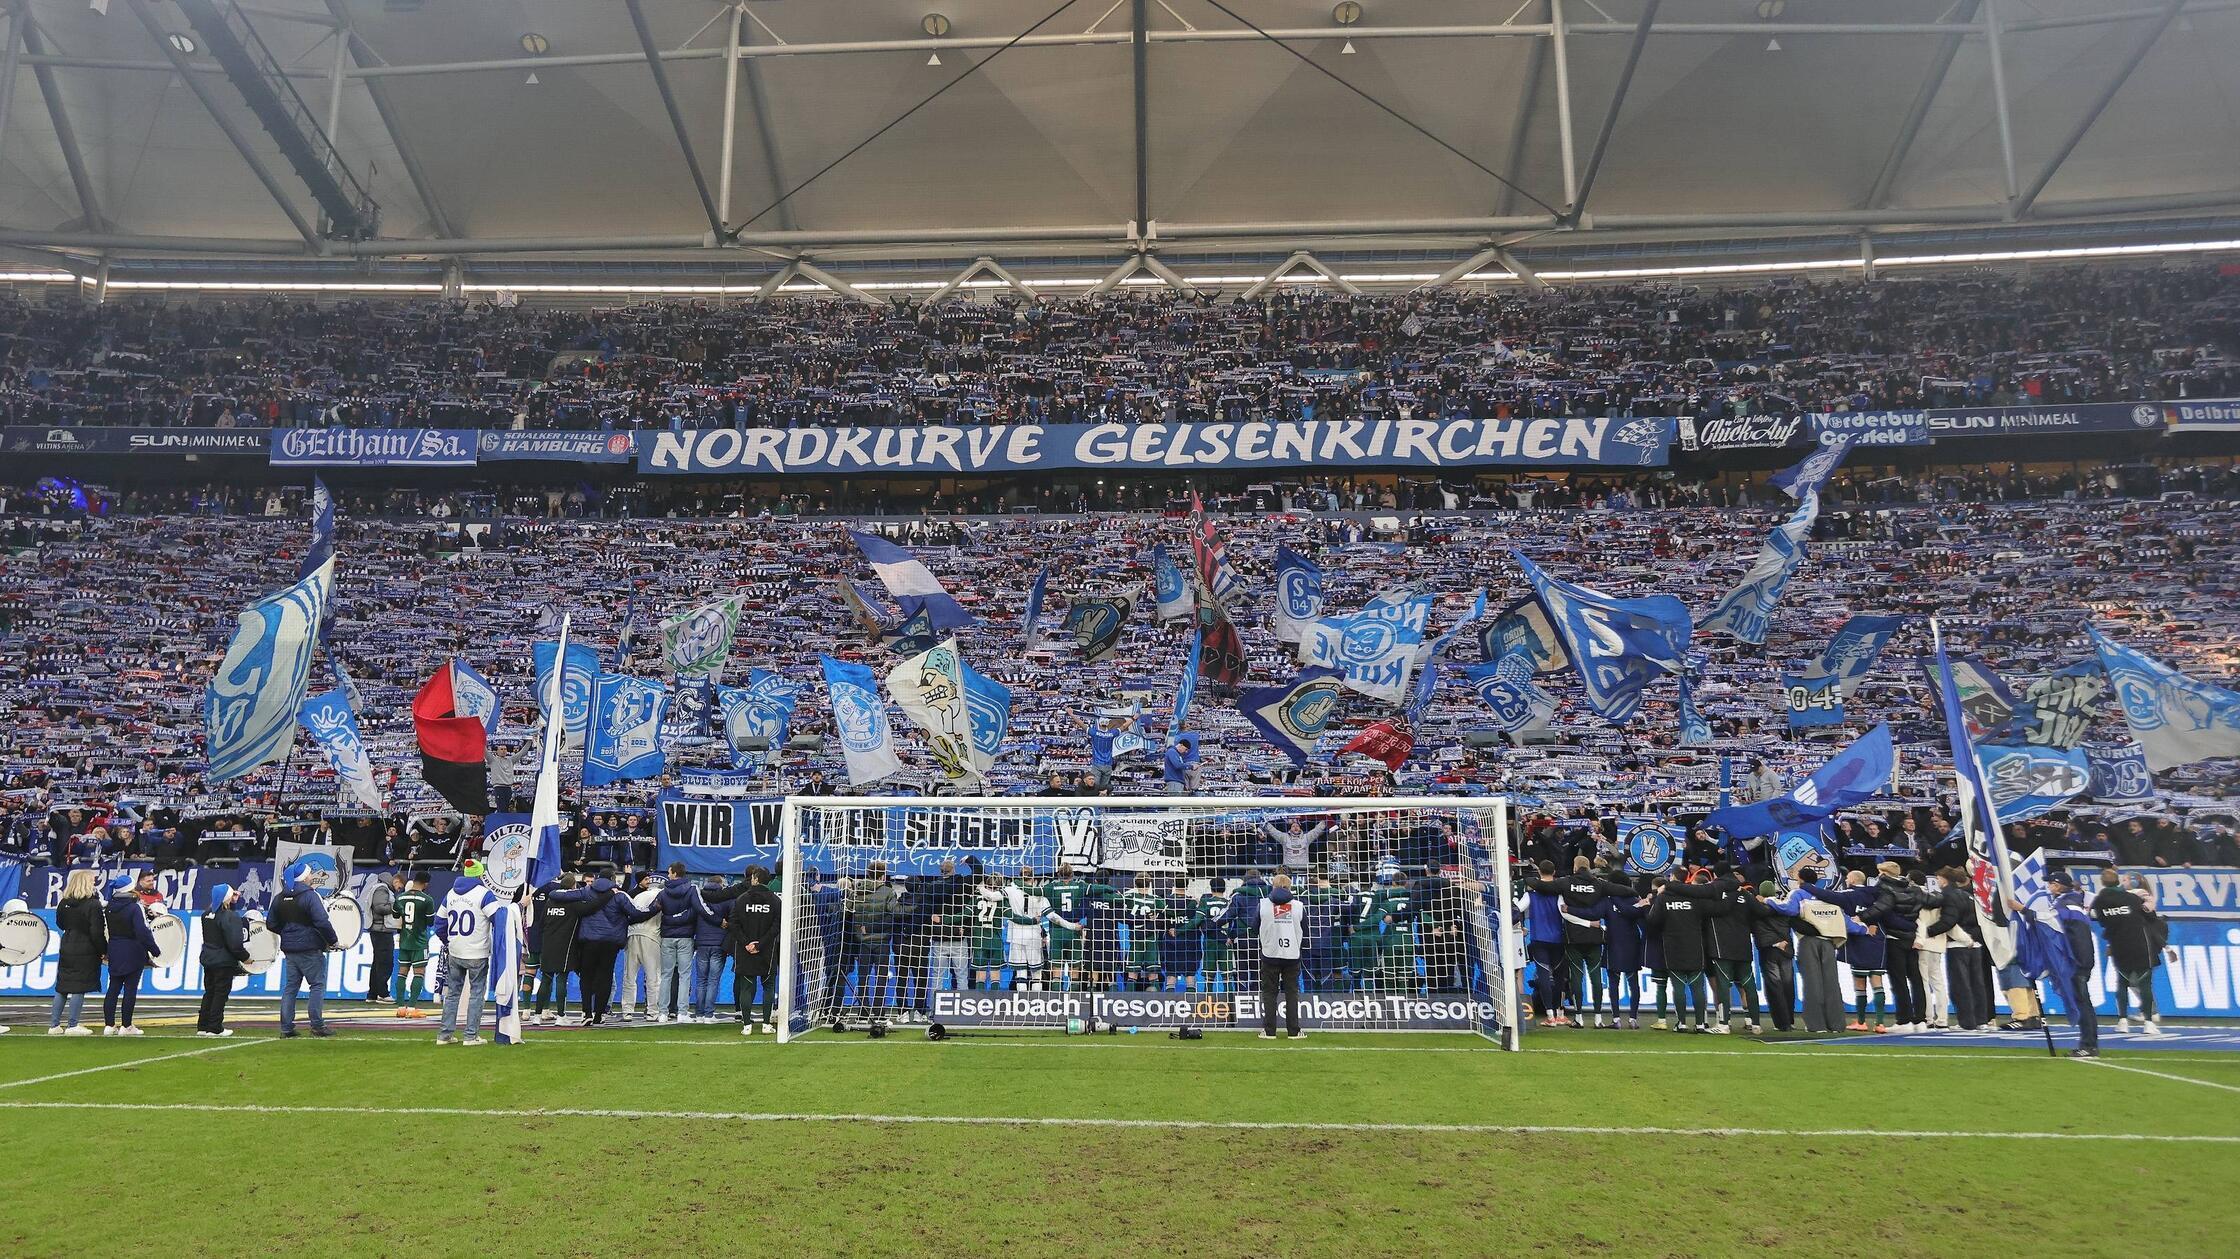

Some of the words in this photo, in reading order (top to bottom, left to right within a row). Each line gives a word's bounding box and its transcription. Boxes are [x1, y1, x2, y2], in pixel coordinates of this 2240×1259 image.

[1929, 416, 1995, 430] SUN
[2000, 412, 2080, 428] MINIMEAL
[503, 432, 561, 441] SCHALKER
[564, 433, 606, 441] FILIALE
[1700, 418, 1753, 446] Glück
[1751, 415, 1801, 445] Auf
[130, 435, 188, 446] SUN
[193, 435, 261, 447] MINIMEAL
[501, 440, 604, 453] HAMBURG
[650, 424, 1044, 473] NORDKURVE
[1074, 418, 1602, 466] GELSENKIRCHEN
[1789, 685, 1835, 712] 04
[681, 776, 708, 786] BLUE
[722, 775, 748, 786] BOYZ
[664, 802, 733, 848] WIR
[489, 824, 533, 843] ULTRA
[1143, 856, 1162, 867] der
[1164, 859, 1184, 868] FCN
[1570, 884, 1595, 893] HRS
[745, 904, 771, 913] HRS
[1060, 892, 1072, 912] 5
[1665, 901, 1692, 910] HRS
[404, 902, 415, 923] 9
[547, 907, 565, 916] HRS
[977, 901, 997, 921] 27
[2103, 906, 2130, 916] HRS
[156, 920, 174, 930] SONOR
[447, 910, 475, 936] 20
[1278, 938, 1290, 948] 03
[935, 992, 1079, 1016] Eisenbach
[1085, 993, 1230, 1019] Tresore.de
[1385, 996, 1495, 1020] Tresore
